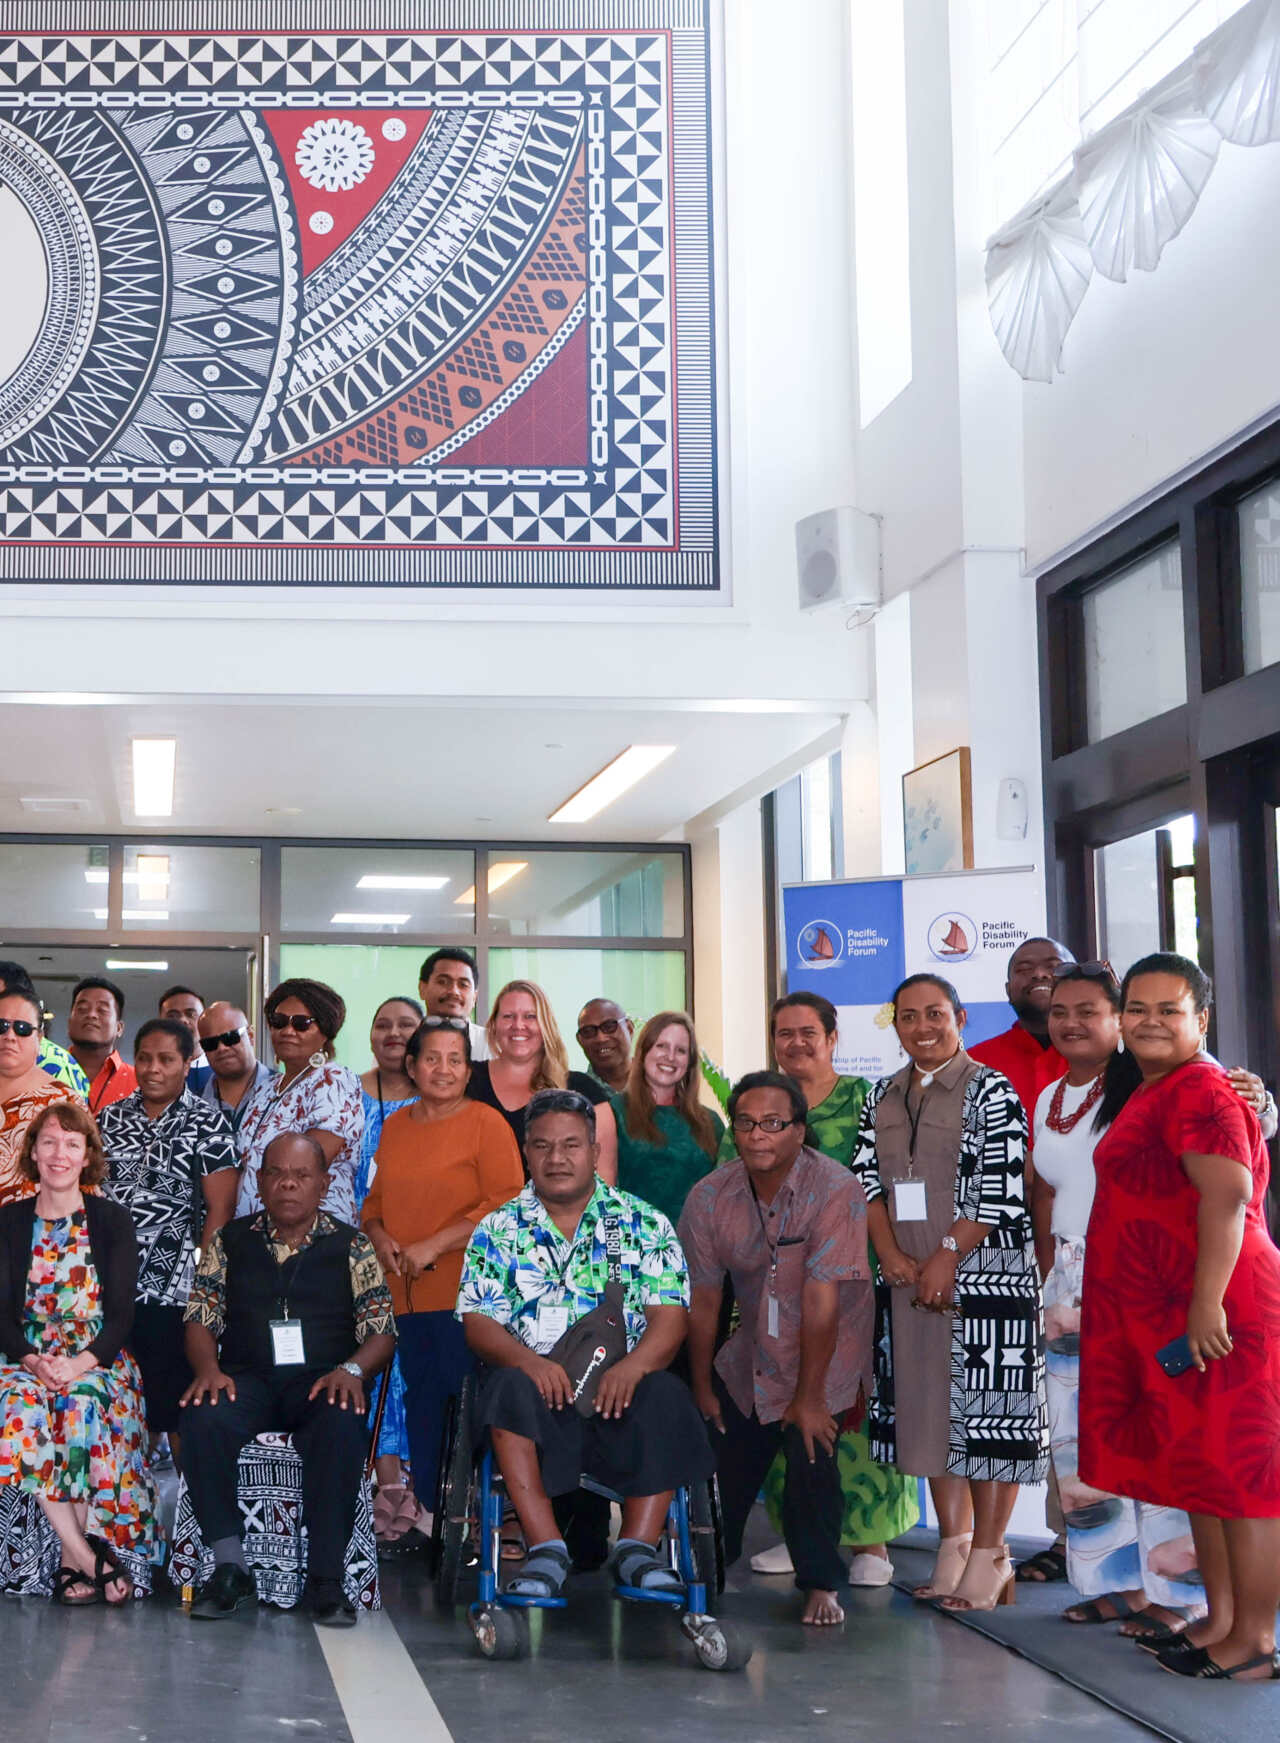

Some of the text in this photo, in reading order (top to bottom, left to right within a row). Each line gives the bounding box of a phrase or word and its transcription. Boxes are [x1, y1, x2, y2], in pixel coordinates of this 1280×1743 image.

[982, 921, 1016, 930] Pacific
[847, 928, 878, 938] Pacific
[982, 929, 1029, 941] Disability
[847, 936, 889, 948] Disability
[983, 939, 1016, 949] Forum
[847, 946, 878, 956] Forum
